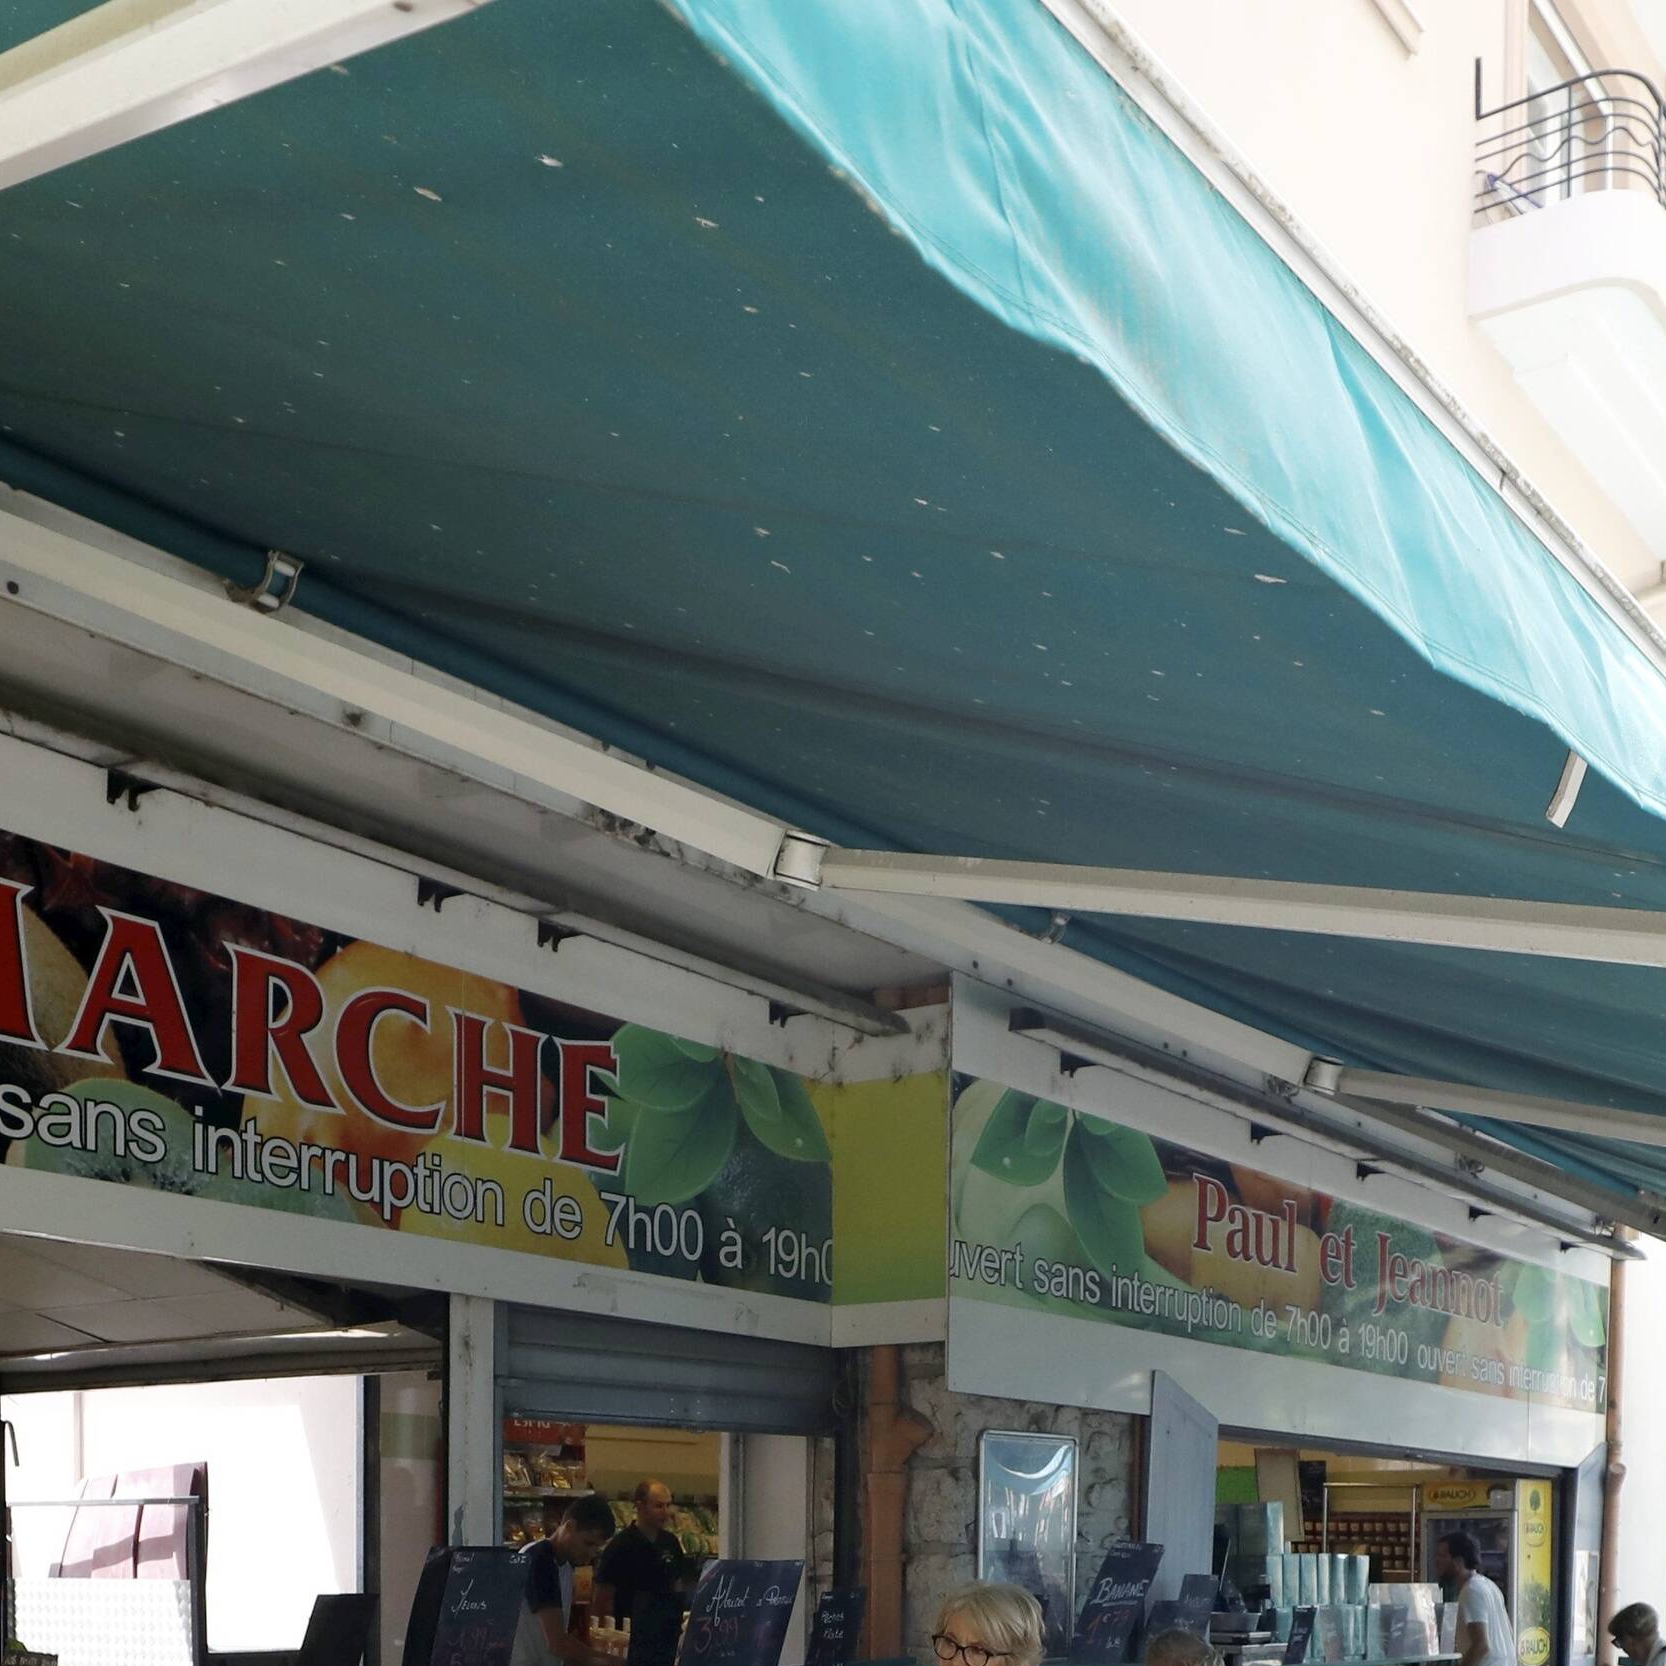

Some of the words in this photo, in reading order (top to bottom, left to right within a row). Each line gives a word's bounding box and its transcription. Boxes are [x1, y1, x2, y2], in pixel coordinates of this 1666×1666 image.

[191, 1104, 506, 1229] interruption
[523, 1178, 583, 1242] de
[599, 1191, 704, 1263] 7h00
[718, 1215, 743, 1271] à
[1193, 1172, 1299, 1275] Paul
[1319, 1224, 1357, 1291] et
[1372, 1232, 1506, 1330] Jeannot
[1033, 1257, 1101, 1305] sans
[1111, 1261, 1243, 1341] interruption
[1251, 1301, 1278, 1339] de
[1284, 1303, 1333, 1352] 7h00
[1337, 1319, 1351, 1356] à
[1357, 1321, 1409, 1366] 19h00
[1417, 1344, 1467, 1378] ouvert
[1471, 1359, 1506, 1386] sans
[1508, 1361, 1578, 1404] interruption
[1579, 1372, 1596, 1400] de
[1096, 1577, 1150, 1602] BANANE
